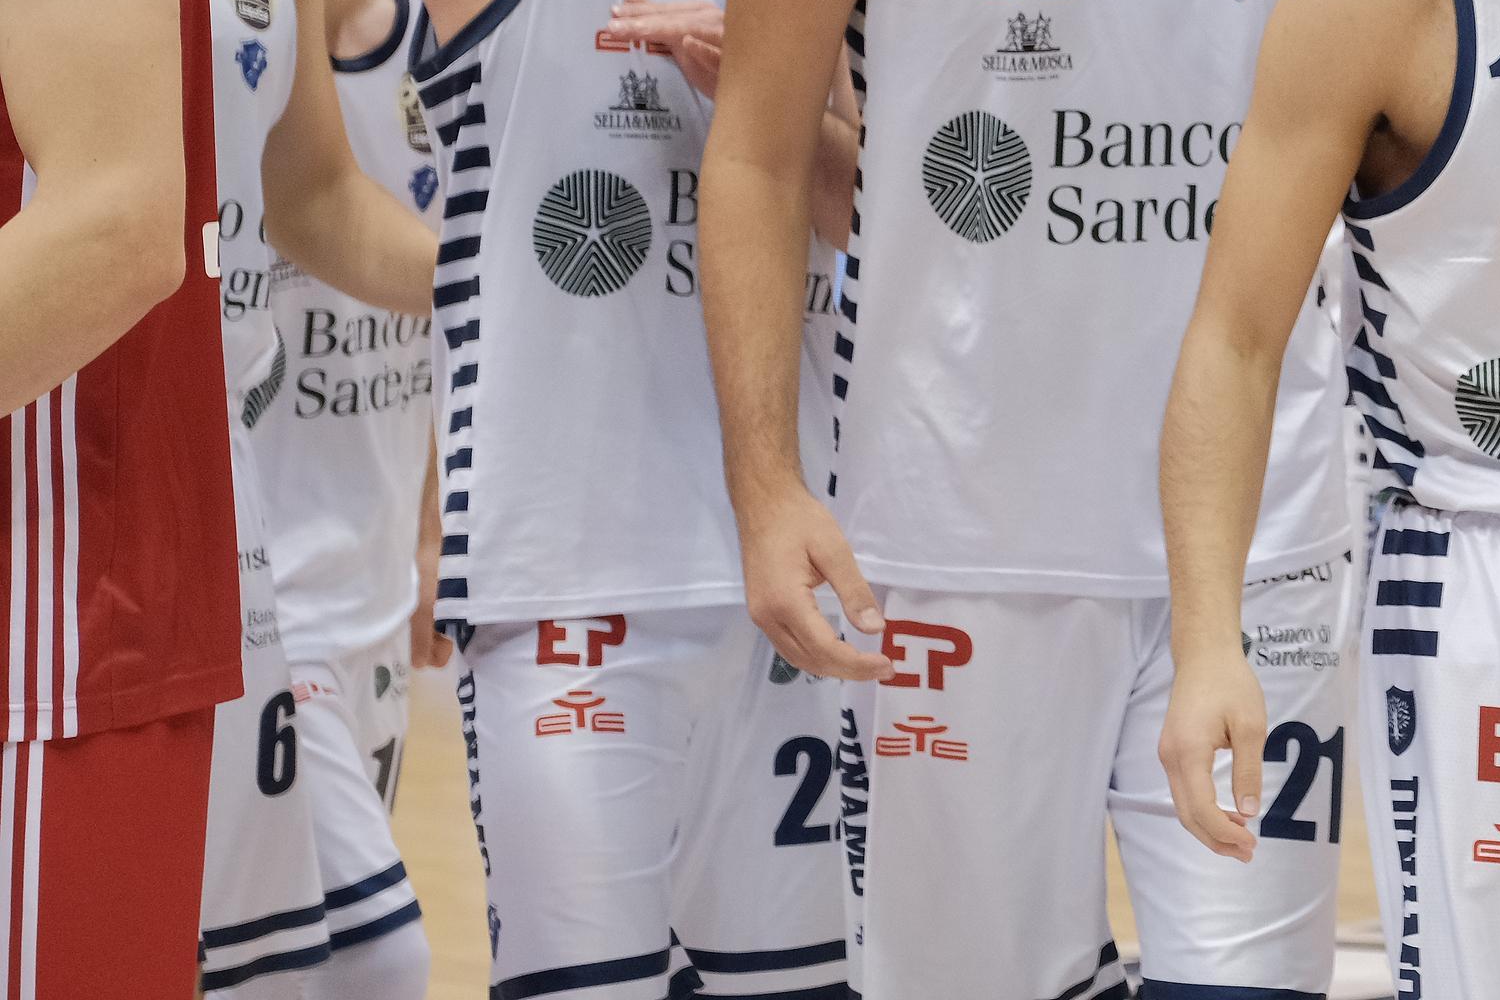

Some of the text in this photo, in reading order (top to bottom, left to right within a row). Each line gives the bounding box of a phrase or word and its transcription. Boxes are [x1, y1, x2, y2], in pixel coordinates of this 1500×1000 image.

[878, 618, 974, 692] EP
[256, 690, 297, 799] 6
[773, 735, 843, 848] 2
[1258, 721, 1346, 845] 21
